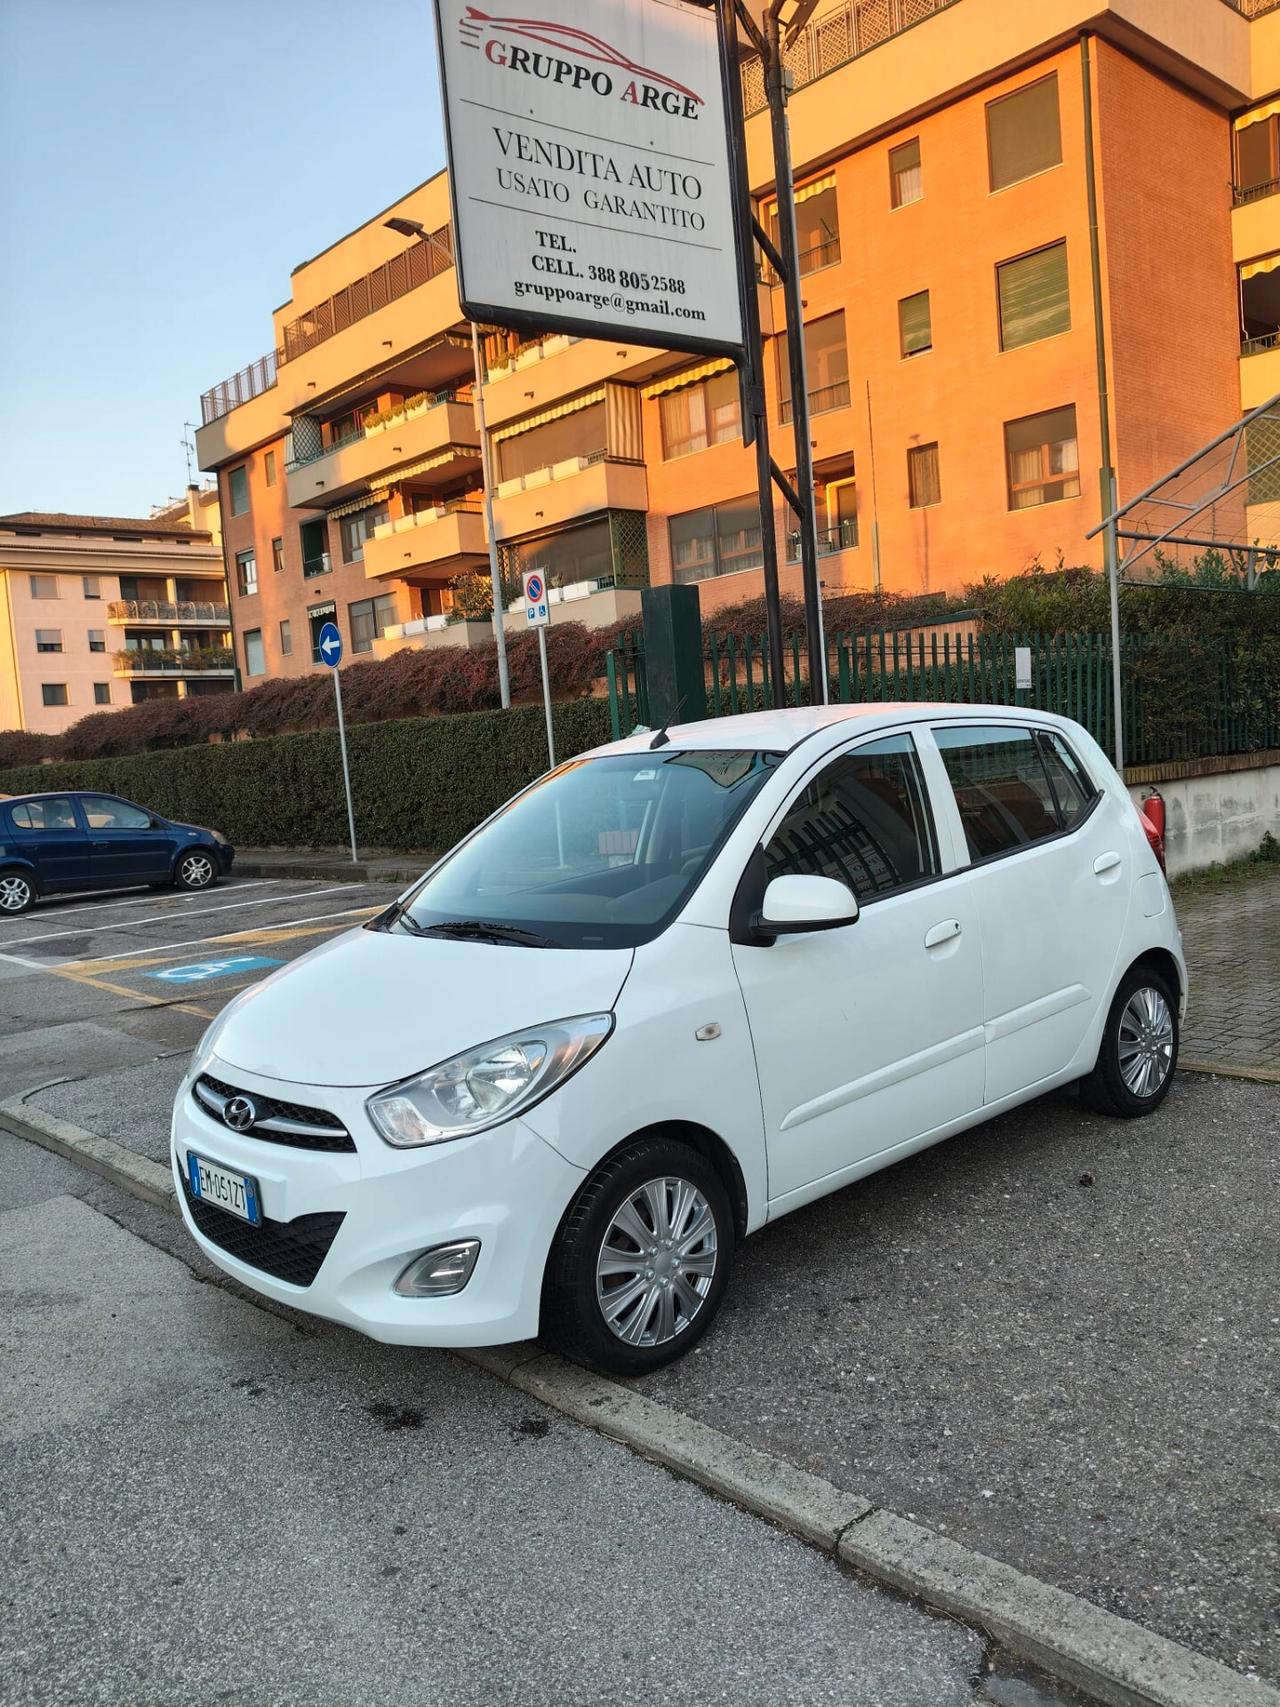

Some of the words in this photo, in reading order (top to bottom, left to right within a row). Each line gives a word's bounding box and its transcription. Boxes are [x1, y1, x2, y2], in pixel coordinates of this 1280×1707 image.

[484, 39, 613, 96] GRUPPO
[620, 81, 699, 120] ARGE
[491, 126, 622, 183] VENDITA
[628, 163, 702, 200] AUTO
[496, 167, 570, 203] USATO
[583, 189, 705, 232] GARANTITO
[535, 230, 577, 253] TEL.
[531, 254, 584, 279] CELL.
[588, 265, 616, 284] 388
[514, 281, 706, 321] gruppoarge@gmail.com
